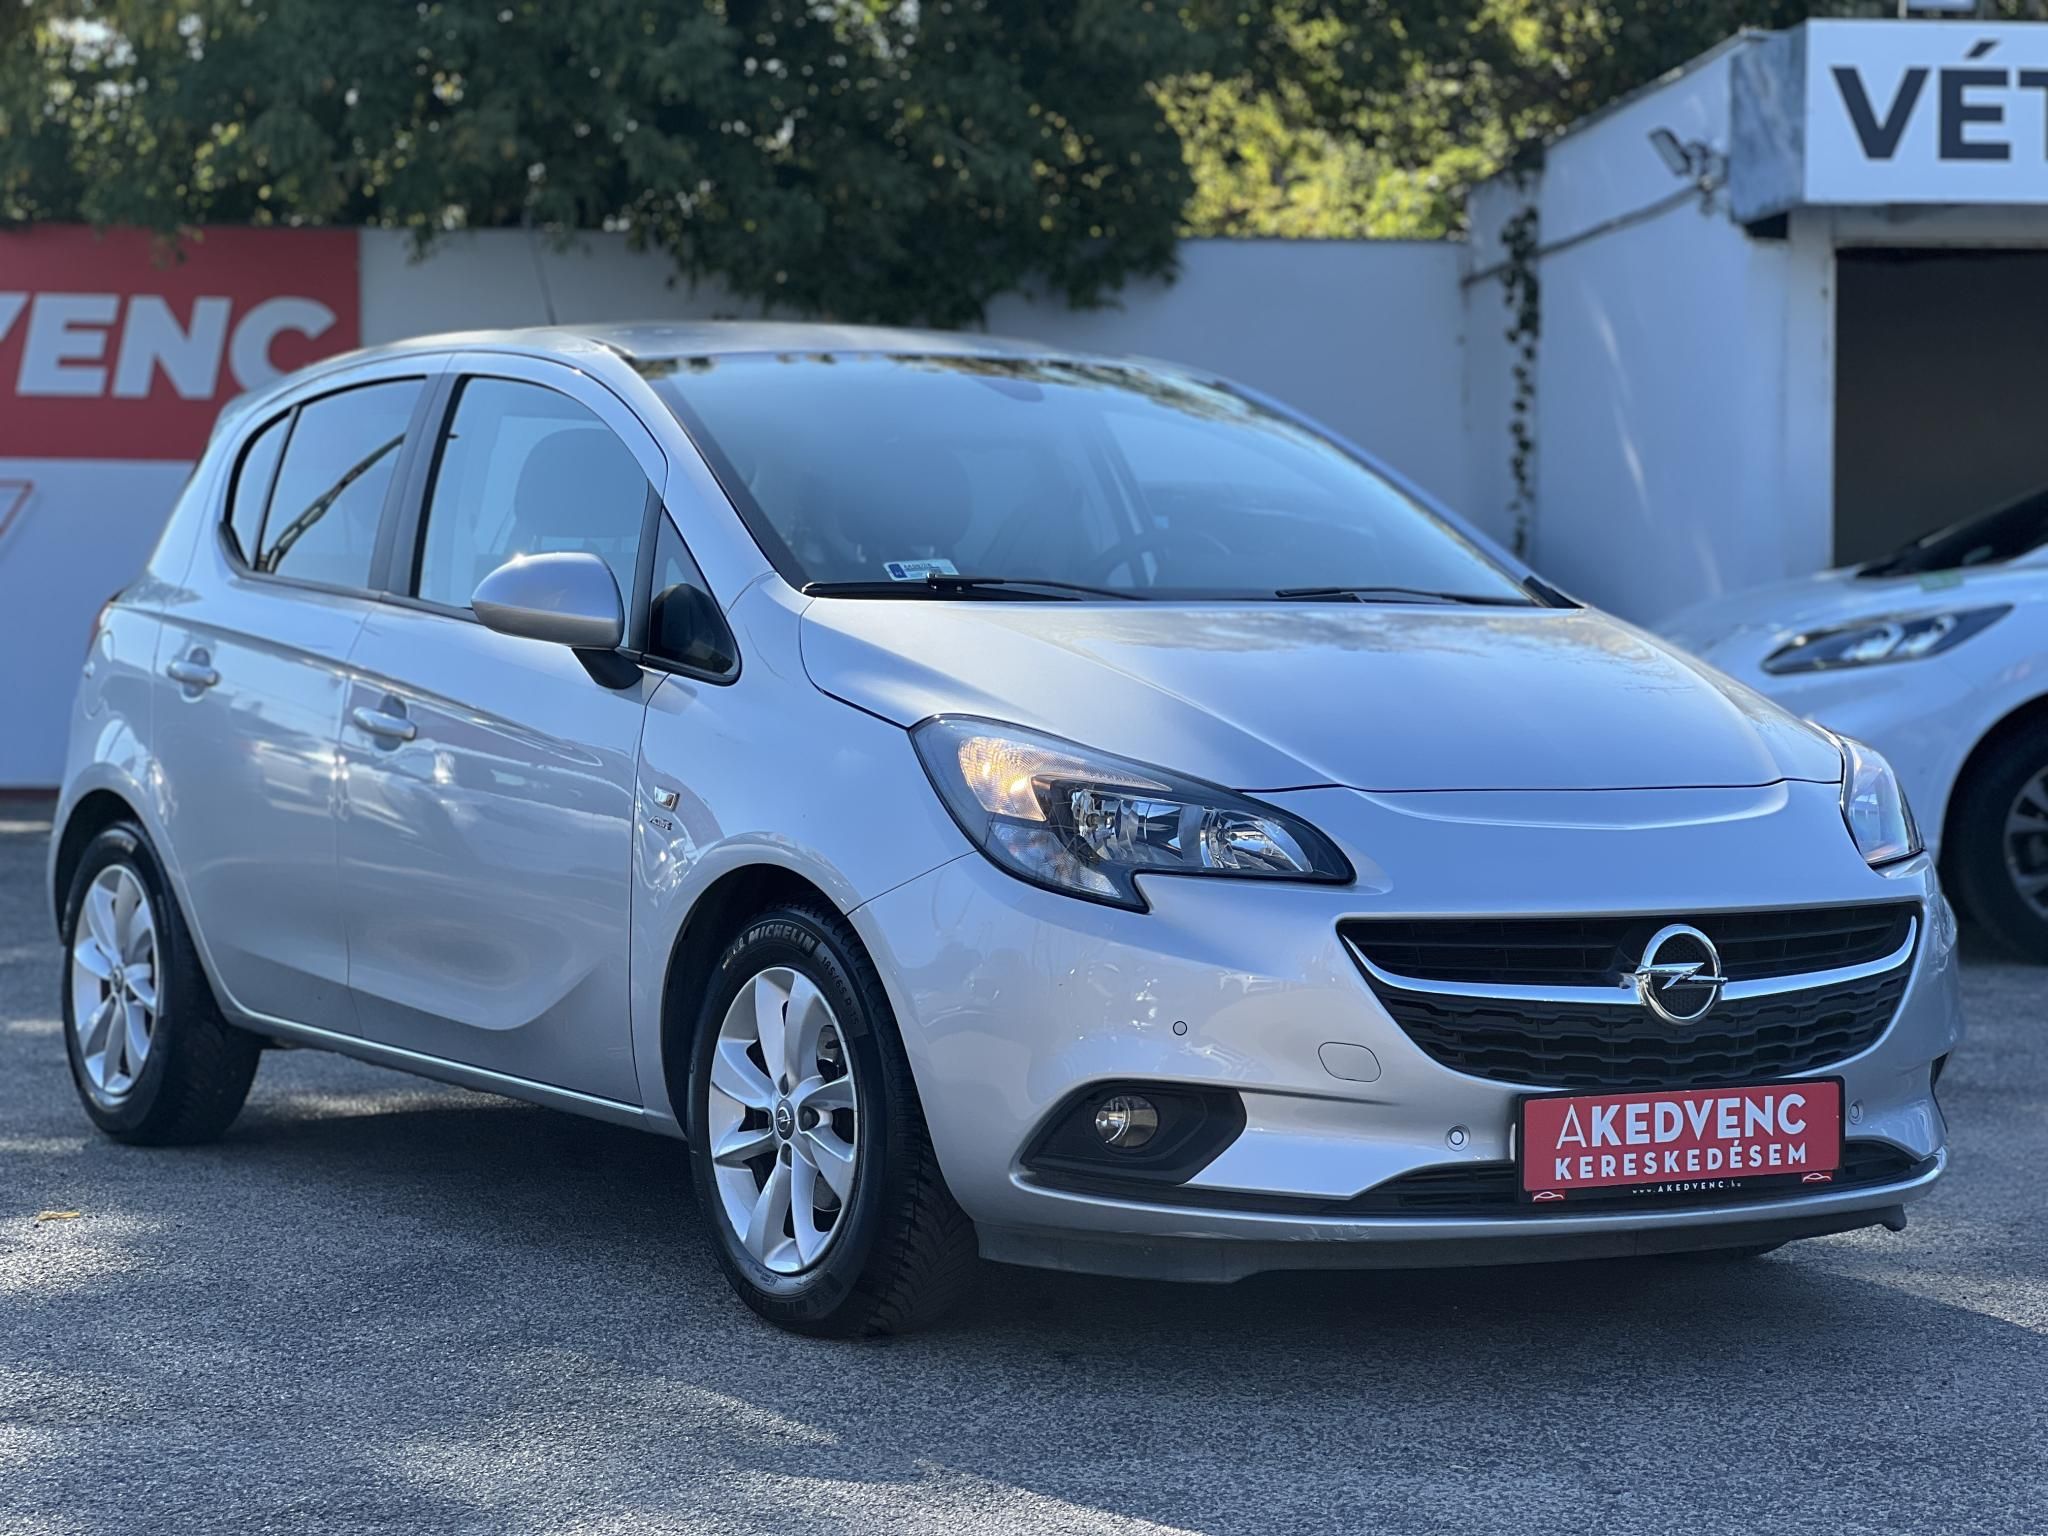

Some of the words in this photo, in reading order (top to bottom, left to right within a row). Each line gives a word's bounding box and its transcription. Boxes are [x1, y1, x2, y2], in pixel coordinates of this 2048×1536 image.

[748, 924, 817, 954] MICHELIN
[1555, 1093, 1807, 1150] AKEDVENC
[1554, 1139, 1807, 1181] KERESKEDÉSEM
